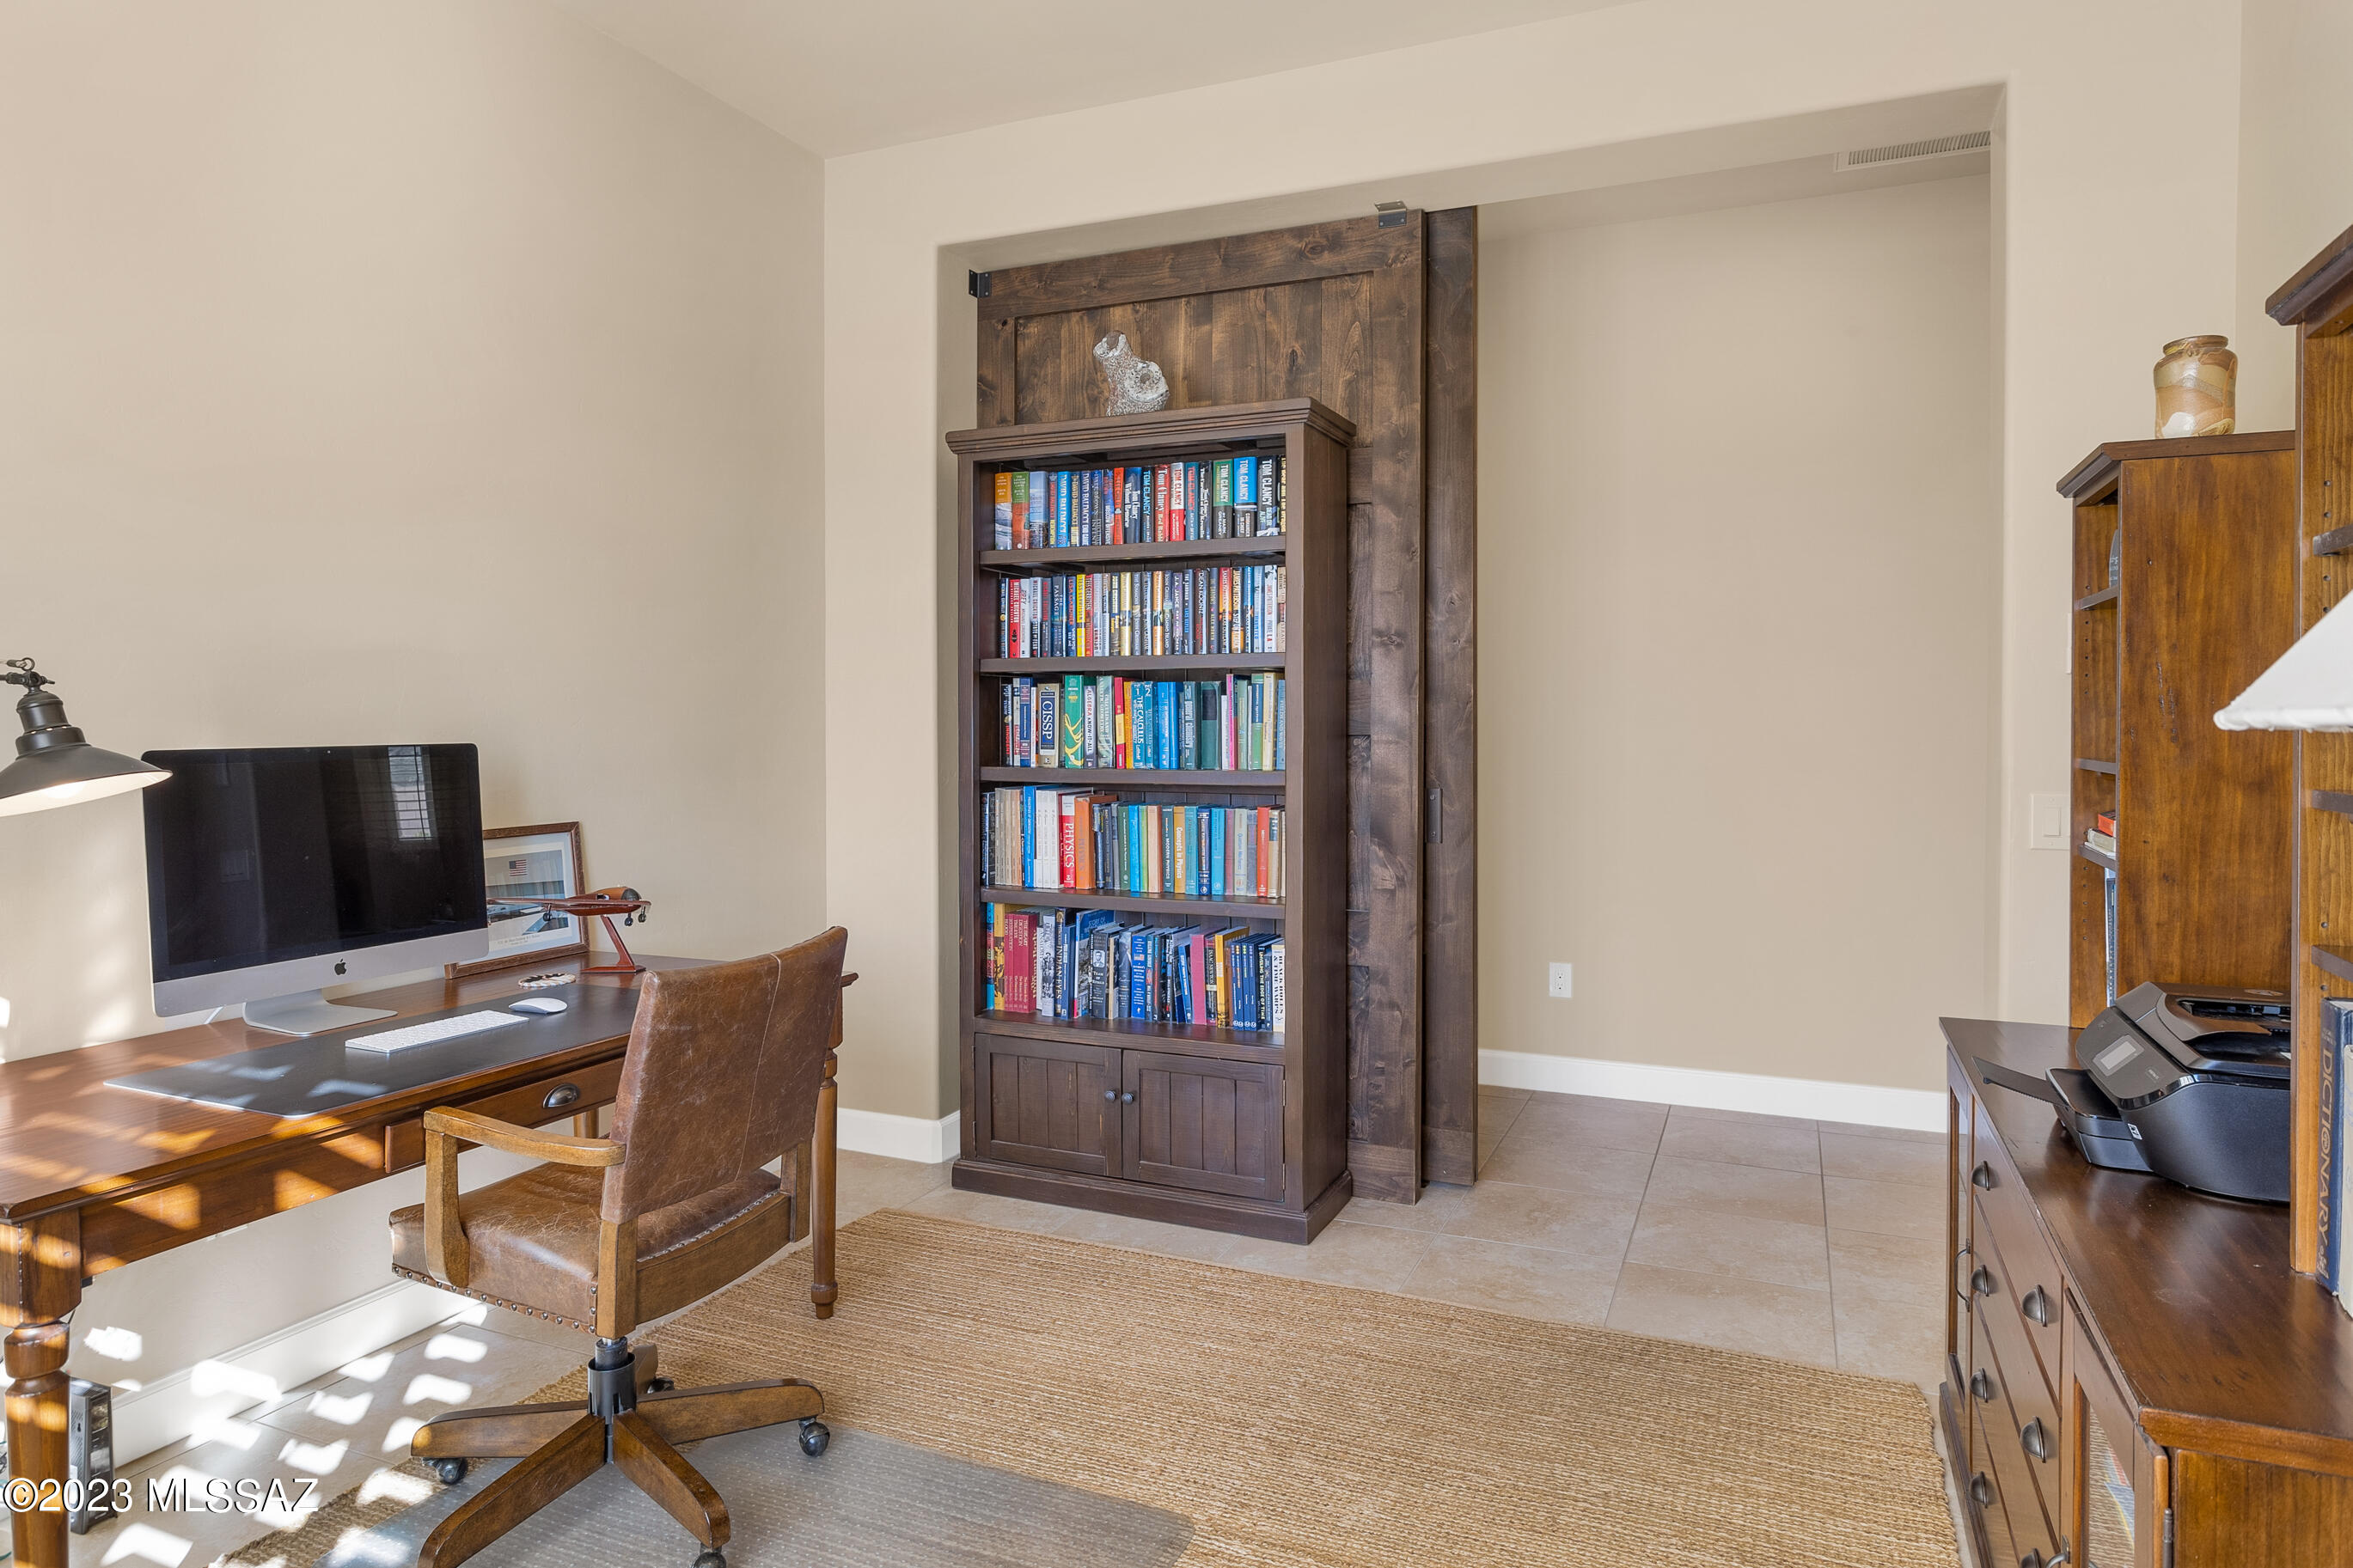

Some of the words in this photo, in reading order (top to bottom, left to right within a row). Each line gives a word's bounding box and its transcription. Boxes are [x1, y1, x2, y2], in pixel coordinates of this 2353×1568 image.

[1158, 468, 1168, 485] Tom
[1239, 460, 1248, 473] TOM
[1262, 459, 1272, 475] TOM
[1059, 474, 1067, 496] DAVID
[1132, 491, 1140, 502] Tom
[1239, 475, 1248, 500] CLANCY
[1262, 478, 1272, 505] CLANCY
[1130, 503, 1140, 519] Clancy
[1155, 487, 1167, 511] Clancy
[1059, 497, 1067, 533] BALDACCI
[1042, 701, 1053, 739] CISSP
[1185, 723, 1195, 747] chemistry
[1065, 823, 1074, 868] PHYSICS
[2319, 1048, 2333, 1246] DICTIONARY
